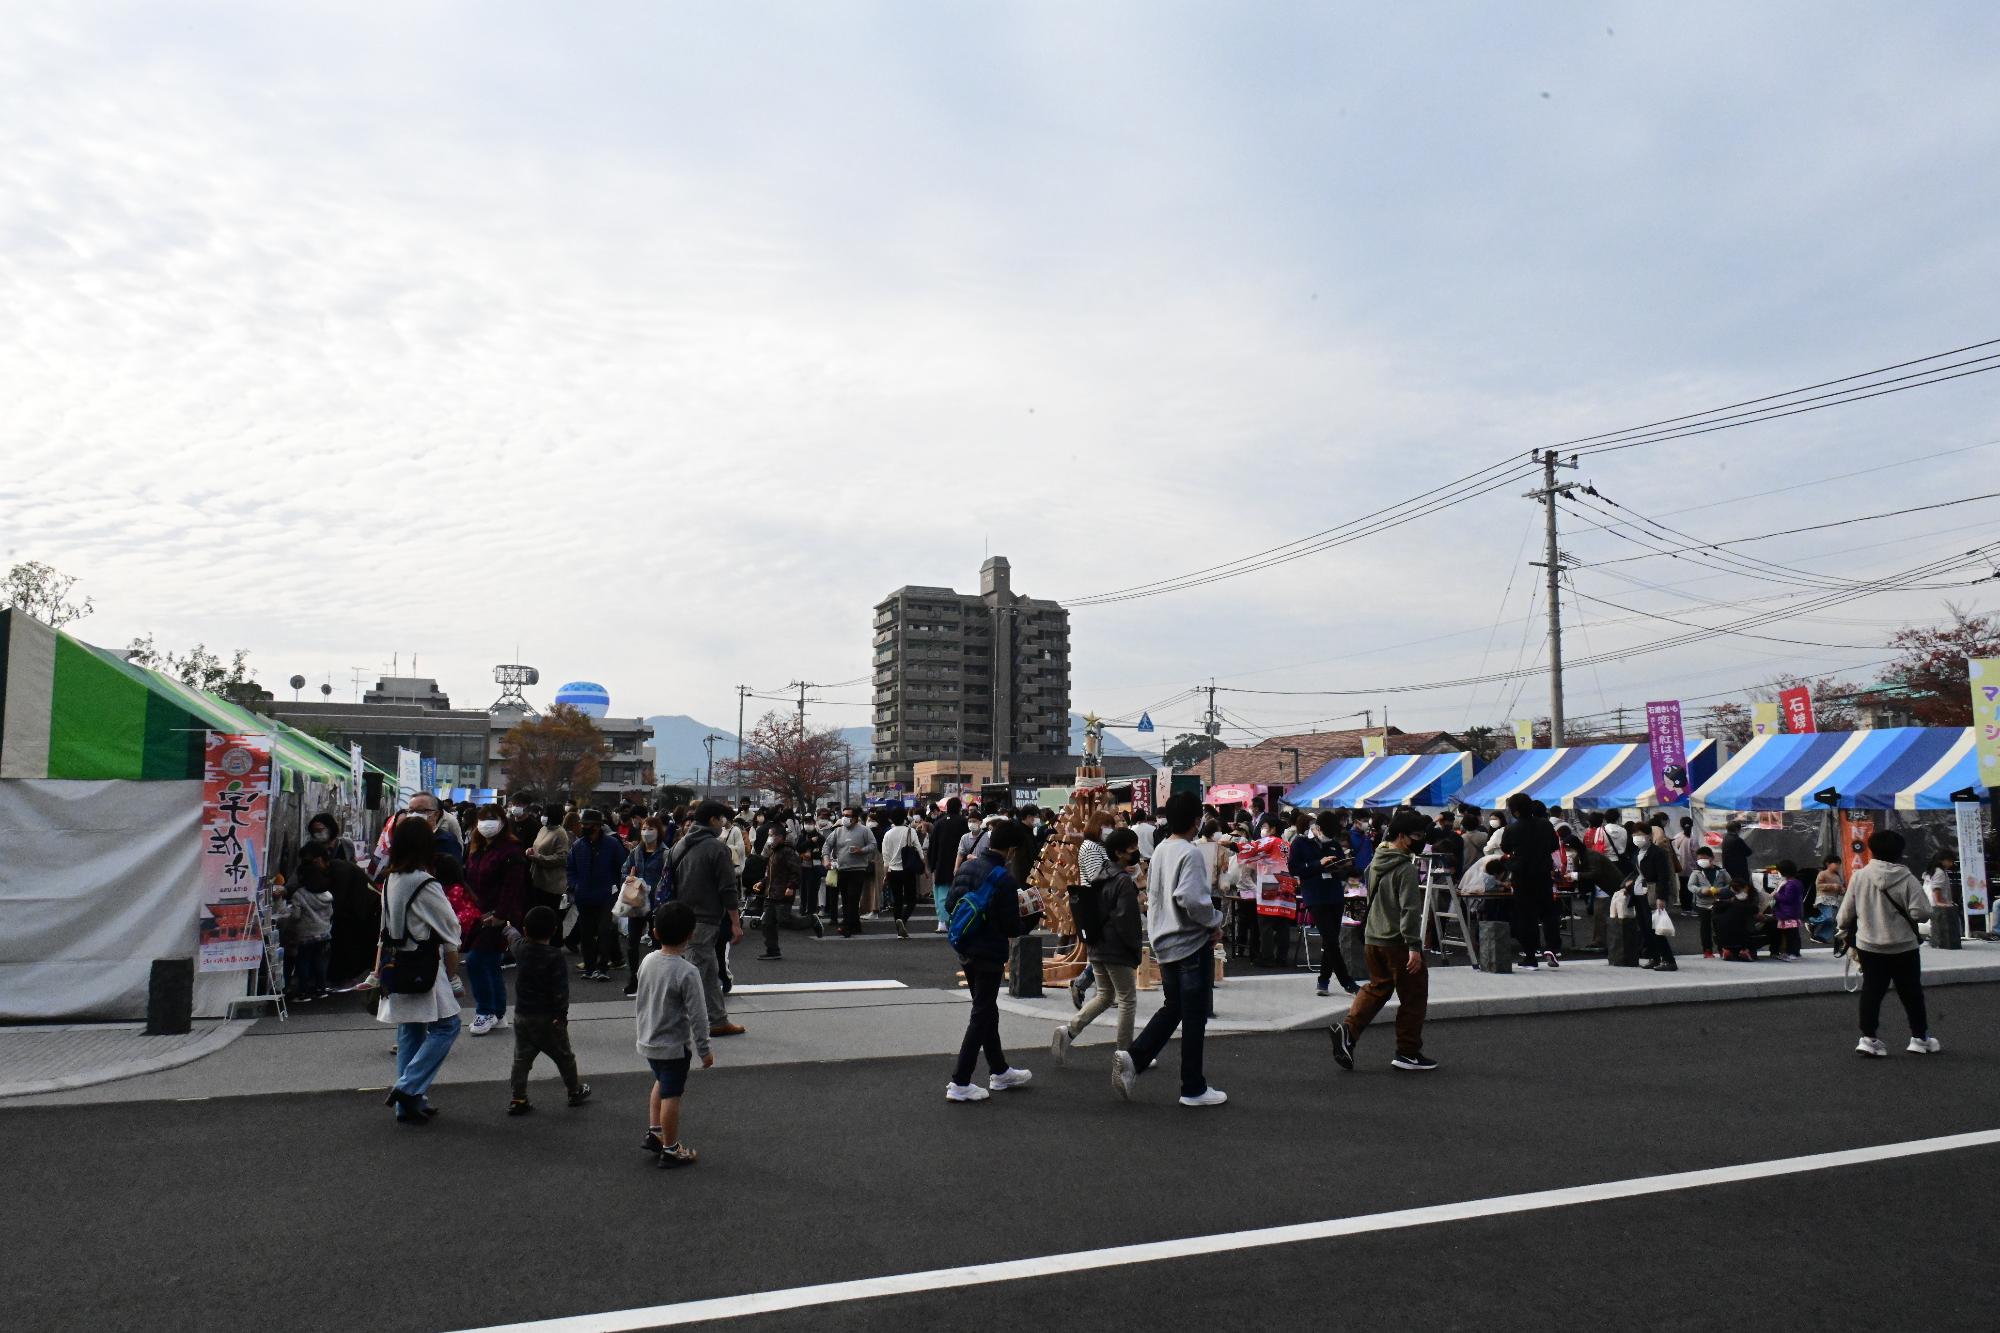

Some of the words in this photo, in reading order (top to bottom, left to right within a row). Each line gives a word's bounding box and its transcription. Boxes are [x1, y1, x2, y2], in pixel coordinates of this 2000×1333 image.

[1657, 715, 1677, 774] 恋も紅はるか
[1789, 697, 1805, 733] 石焼
[1982, 686, 2000, 757] マシ
